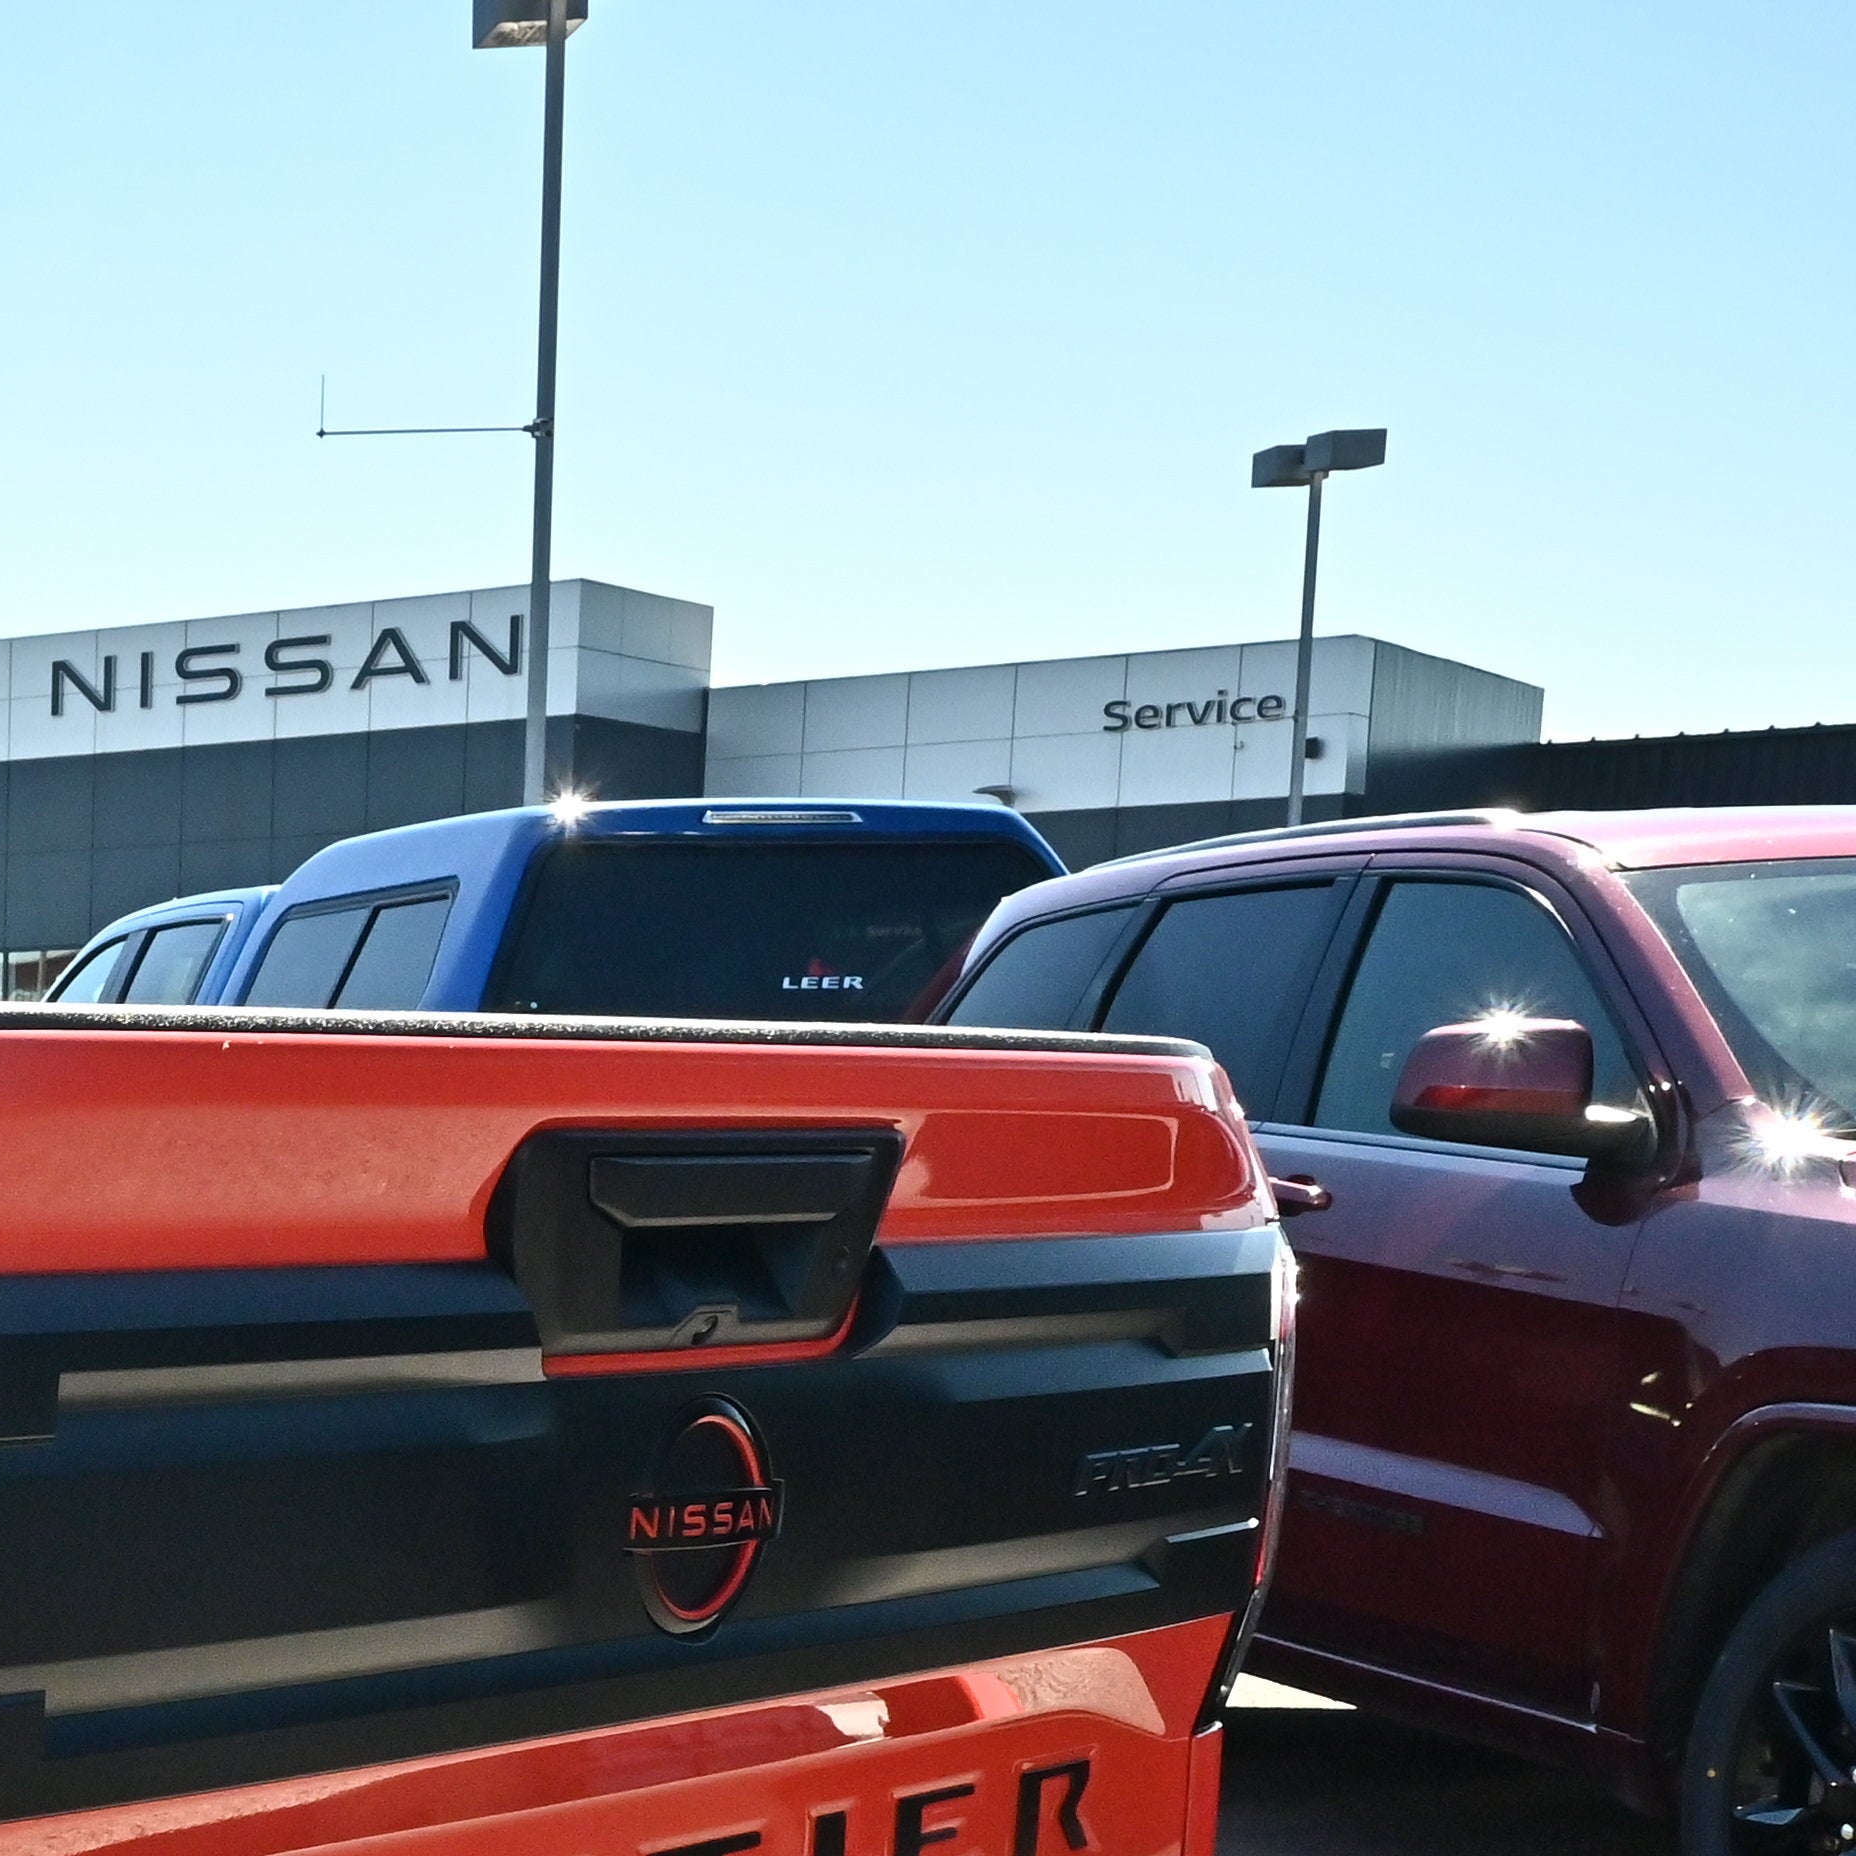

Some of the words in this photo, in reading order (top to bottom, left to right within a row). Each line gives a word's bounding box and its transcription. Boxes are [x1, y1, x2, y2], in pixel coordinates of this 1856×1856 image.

[50, 613, 525, 718] NISSAN
[1102, 689, 1286, 733] Service
[781, 975, 864, 990] LEER
[629, 1496, 775, 1541] NISSAN
